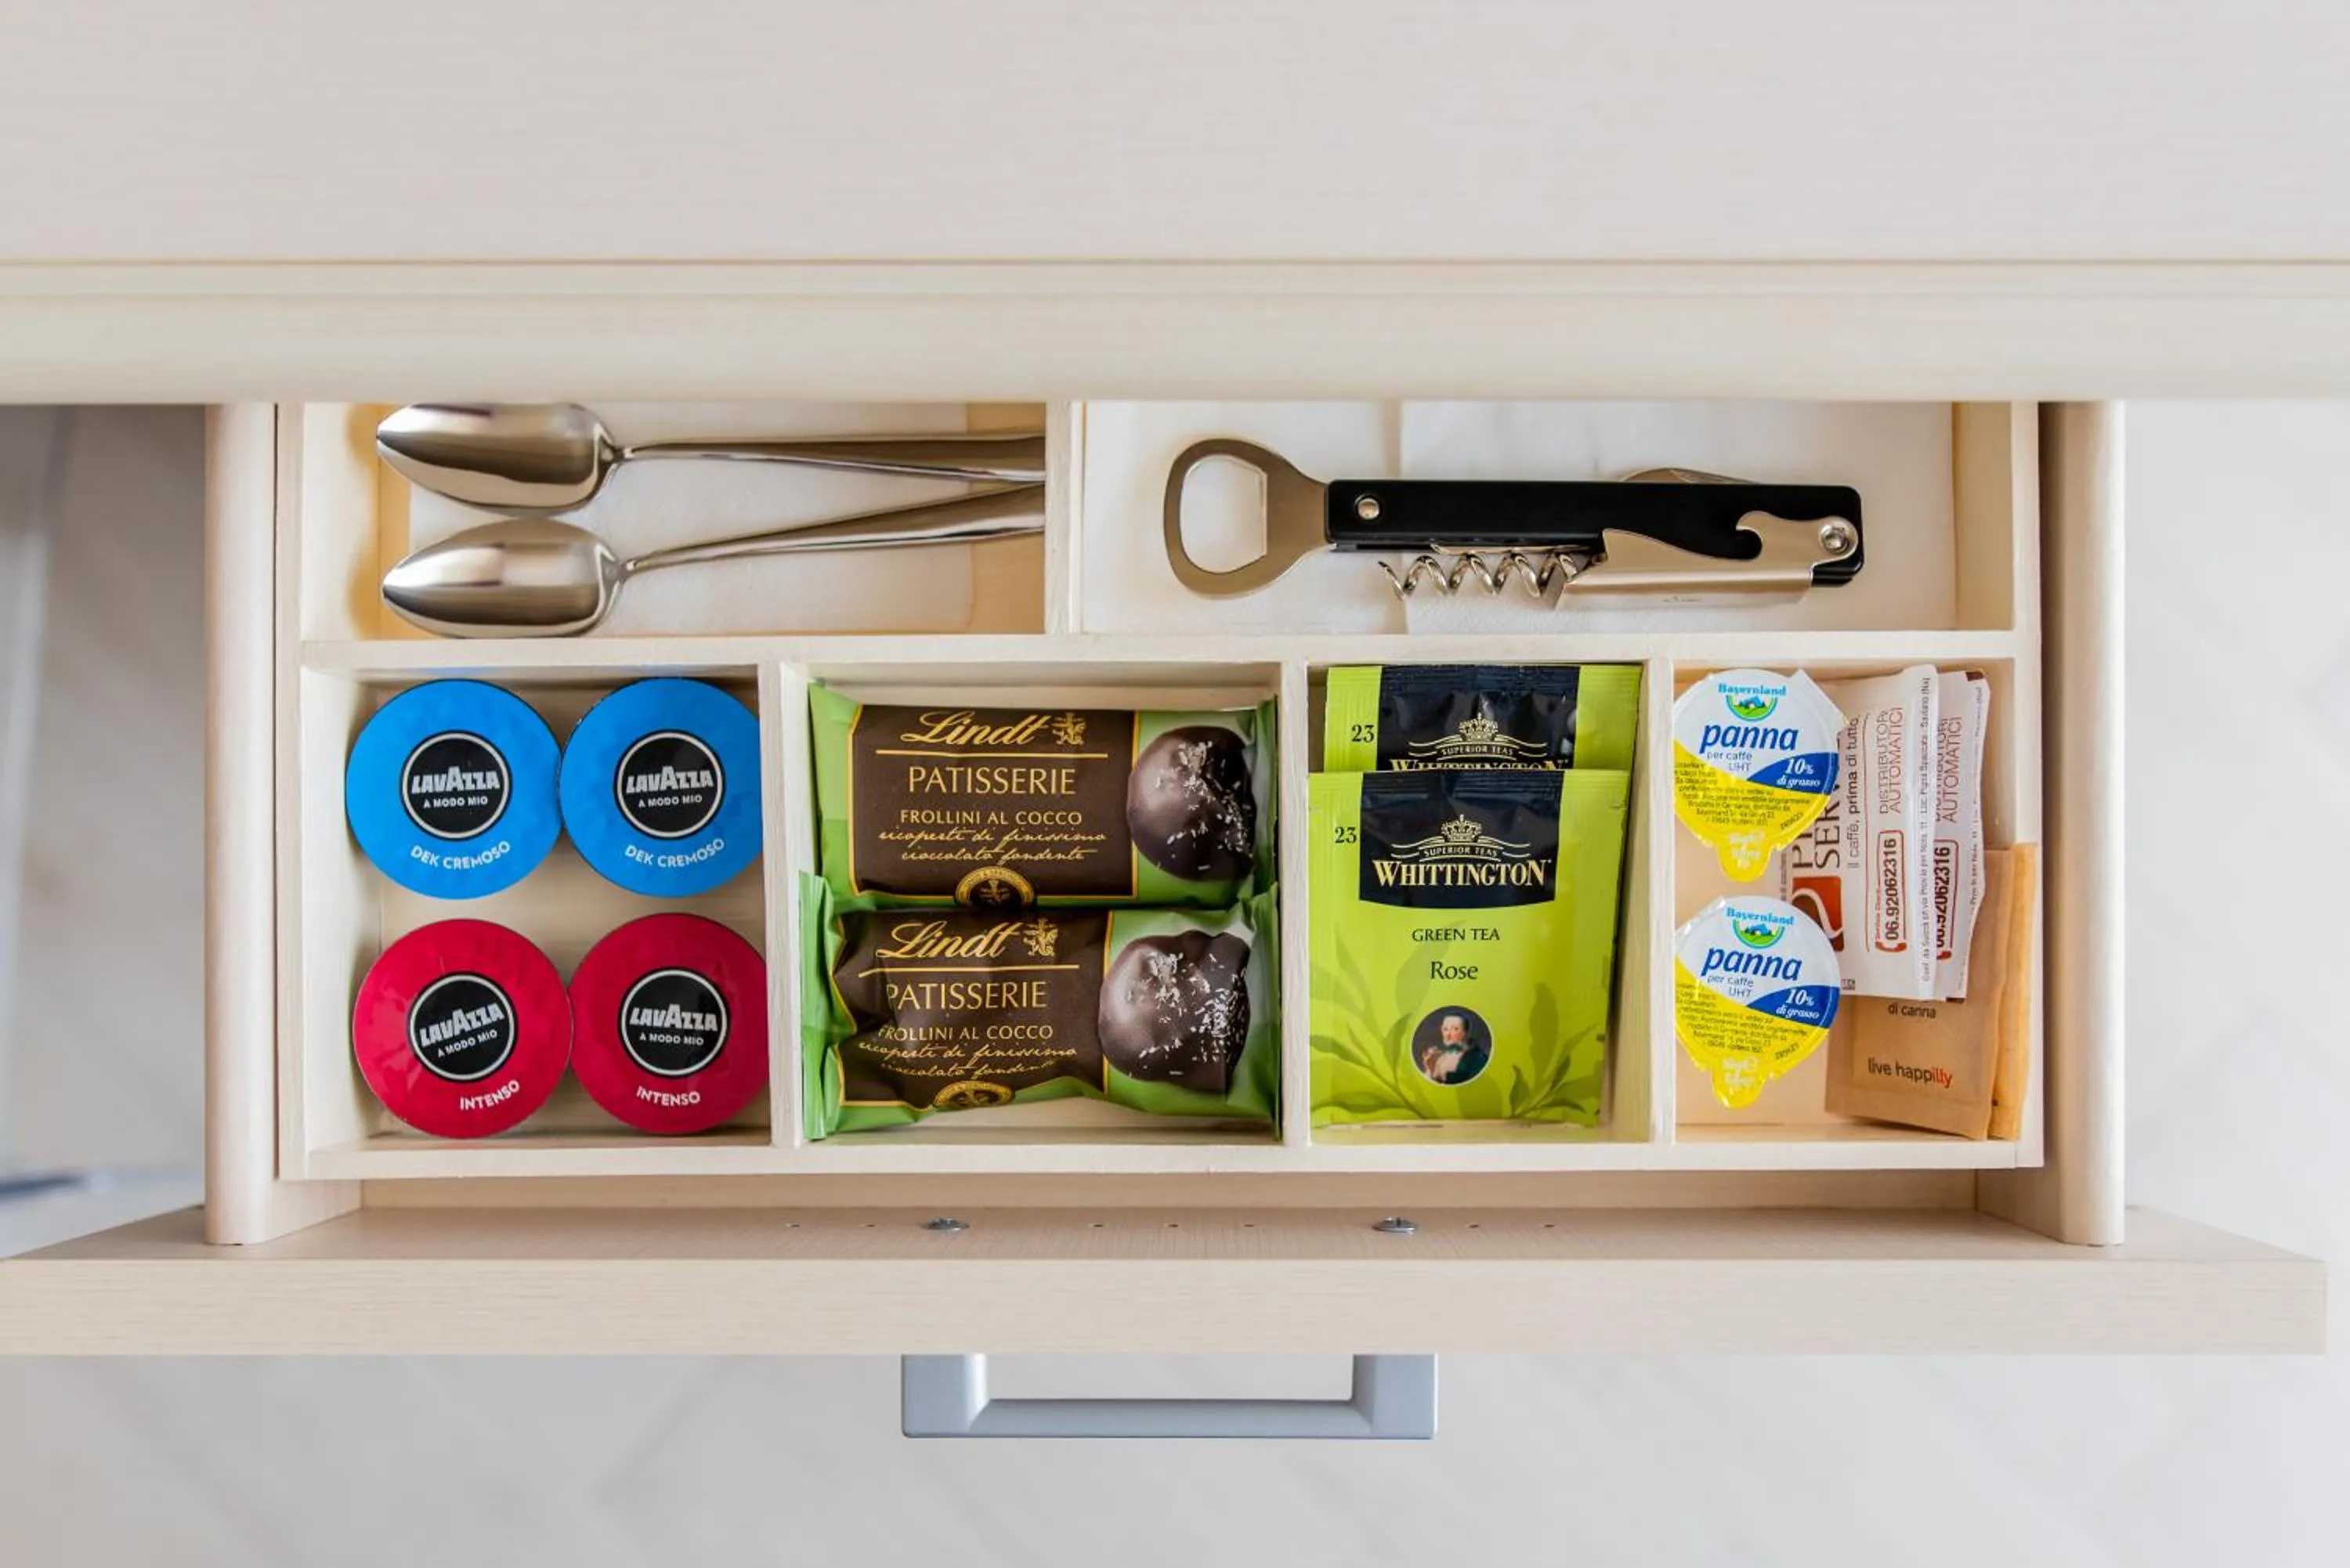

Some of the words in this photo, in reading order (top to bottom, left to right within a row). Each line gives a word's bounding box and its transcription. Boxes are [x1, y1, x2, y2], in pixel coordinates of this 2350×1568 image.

[1718, 682, 1787, 696] Bayernland
[900, 710, 1050, 746] Lindt
[1351, 724, 1375, 742] 23
[1699, 724, 1799, 754] panna
[1441, 745, 1487, 755] SUPERIOR
[1491, 745, 1513, 756] TEAS
[1707, 751, 1723, 761] per
[1846, 754, 1858, 767] di
[1729, 762, 1752, 771] UHT
[1785, 757, 1814, 776] 10%
[1889, 707, 1904, 815] AUTOMATICI
[1942, 716, 1962, 824] AUTOMATICI
[410, 765, 501, 794] LAVAZZA
[625, 765, 714, 794] LAVAZZA
[909, 766, 1076, 796] PATISSERIE
[1776, 775, 1788, 786] di
[1788, 779, 1820, 789] grasso
[423, 799, 432, 809] A
[433, 797, 465, 807] MODO
[468, 795, 488, 806] MIO
[638, 799, 646, 808] A
[648, 797, 680, 807] MODO
[682, 794, 703, 805] MIO
[1847, 771, 1864, 815] prima
[901, 809, 980, 825] FROLLINI
[987, 810, 1009, 825] AL
[1015, 811, 1083, 825] COCCO
[878, 825, 976, 848] ricoperti
[972, 826, 996, 841] di
[993, 826, 1106, 853] finissimo
[1335, 826, 1358, 844] 23
[410, 844, 439, 867] DEK
[443, 840, 512, 869] CREMOSO
[624, 844, 653, 867] DEK
[656, 838, 725, 868] CREMOSO
[901, 846, 1004, 862] cioccolato
[996, 845, 1098, 865] fondente
[1424, 845, 1472, 858] SUPERIOR
[1475, 846, 1498, 858] TEAS
[1372, 859, 1549, 887] WHITTINGTON
[1883, 838, 1900, 941] 06.92062316
[1726, 907, 1794, 926] Bayernland
[875, 919, 1023, 959] Lindt
[1412, 927, 1466, 942] GREEN
[1470, 927, 1501, 941] TEA
[1430, 961, 1479, 981] Rose
[1701, 947, 1803, 981] panna
[1708, 975, 1725, 985] per
[886, 981, 1047, 1010] PATISSERIE
[1729, 987, 1752, 999] UHT
[1785, 988, 1815, 1006] 10%
[629, 1003, 718, 1032] LAVAZZA
[1776, 1006, 1788, 1016] di
[1787, 1008, 1820, 1019] grasso
[1888, 1003, 1898, 1014] di
[1901, 1006, 1936, 1019] canna
[420, 1003, 505, 1048] LAVAZZA
[878, 1026, 953, 1042] FROLLINI
[959, 1027, 979, 1040] AL
[986, 1024, 1054, 1040] COCCO
[437, 1046, 446, 1058] A
[446, 1038, 476, 1056] MODO
[478, 1029, 498, 1046] MIO
[639, 1032, 647, 1042] A
[649, 1033, 679, 1044] MODO
[683, 1035, 705, 1047] MIO
[943, 1042, 967, 1058] di
[965, 1042, 1078, 1069] finissimo
[1868, 1057, 1892, 1076] live
[1895, 1059, 1953, 1089] happilly
[459, 1079, 521, 1111] INTENSO
[636, 1086, 701, 1107] INTENSO
